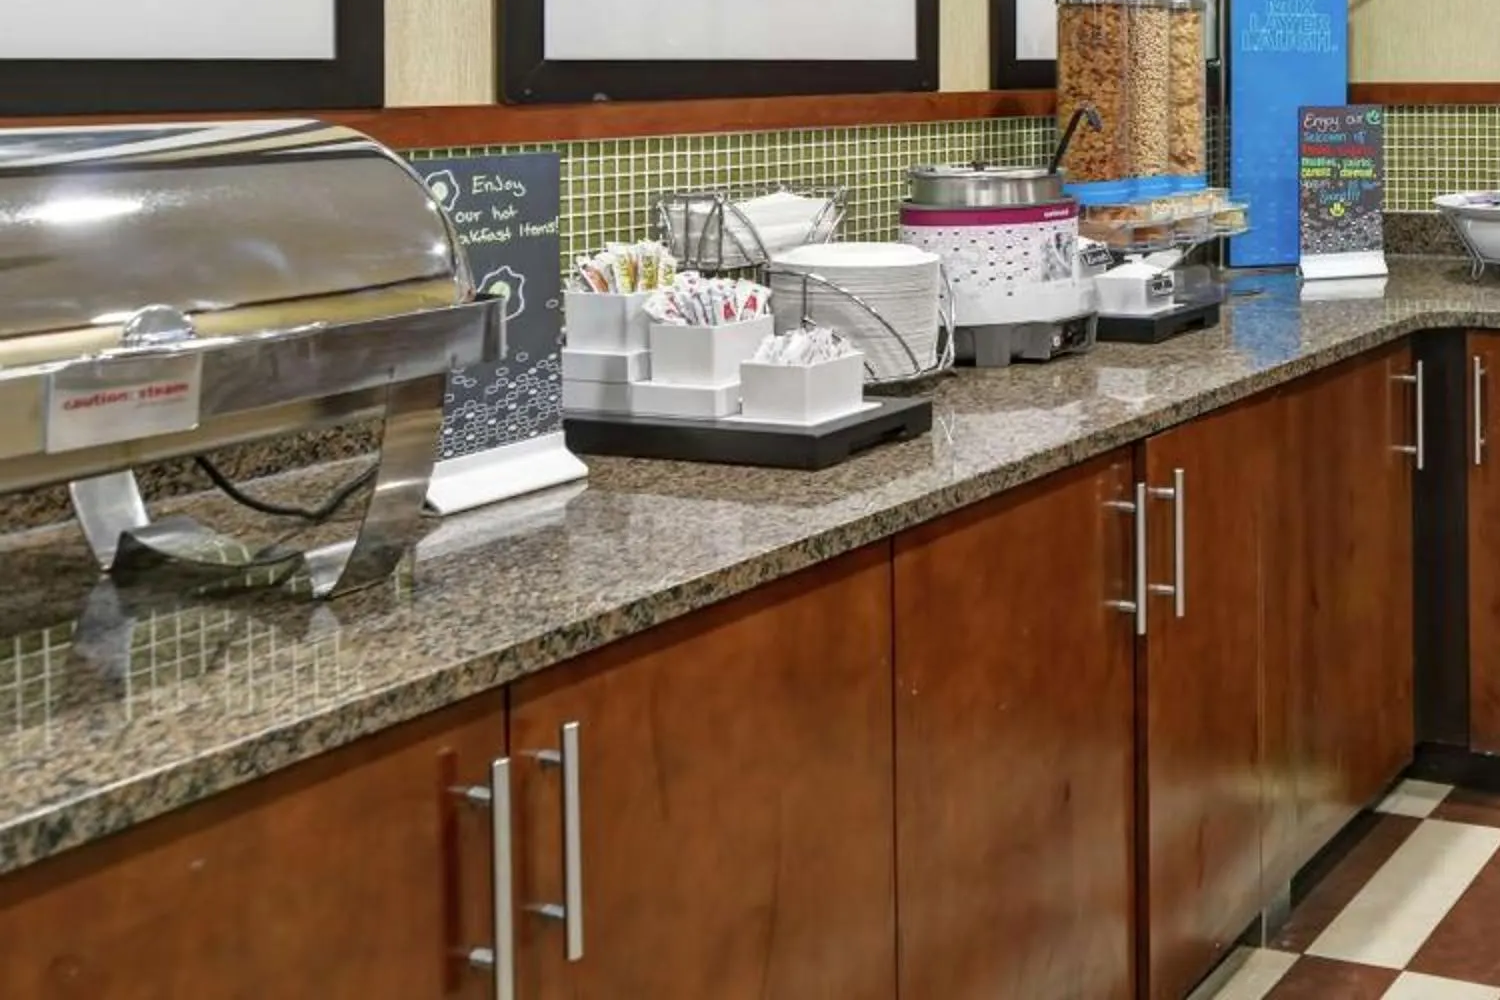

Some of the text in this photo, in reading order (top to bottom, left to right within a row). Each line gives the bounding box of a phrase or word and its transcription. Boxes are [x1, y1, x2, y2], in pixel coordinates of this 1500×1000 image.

[1250, 13, 1331, 34] LAYER
[455, 204, 518, 223] our hot
[63, 391, 128, 411] caution
